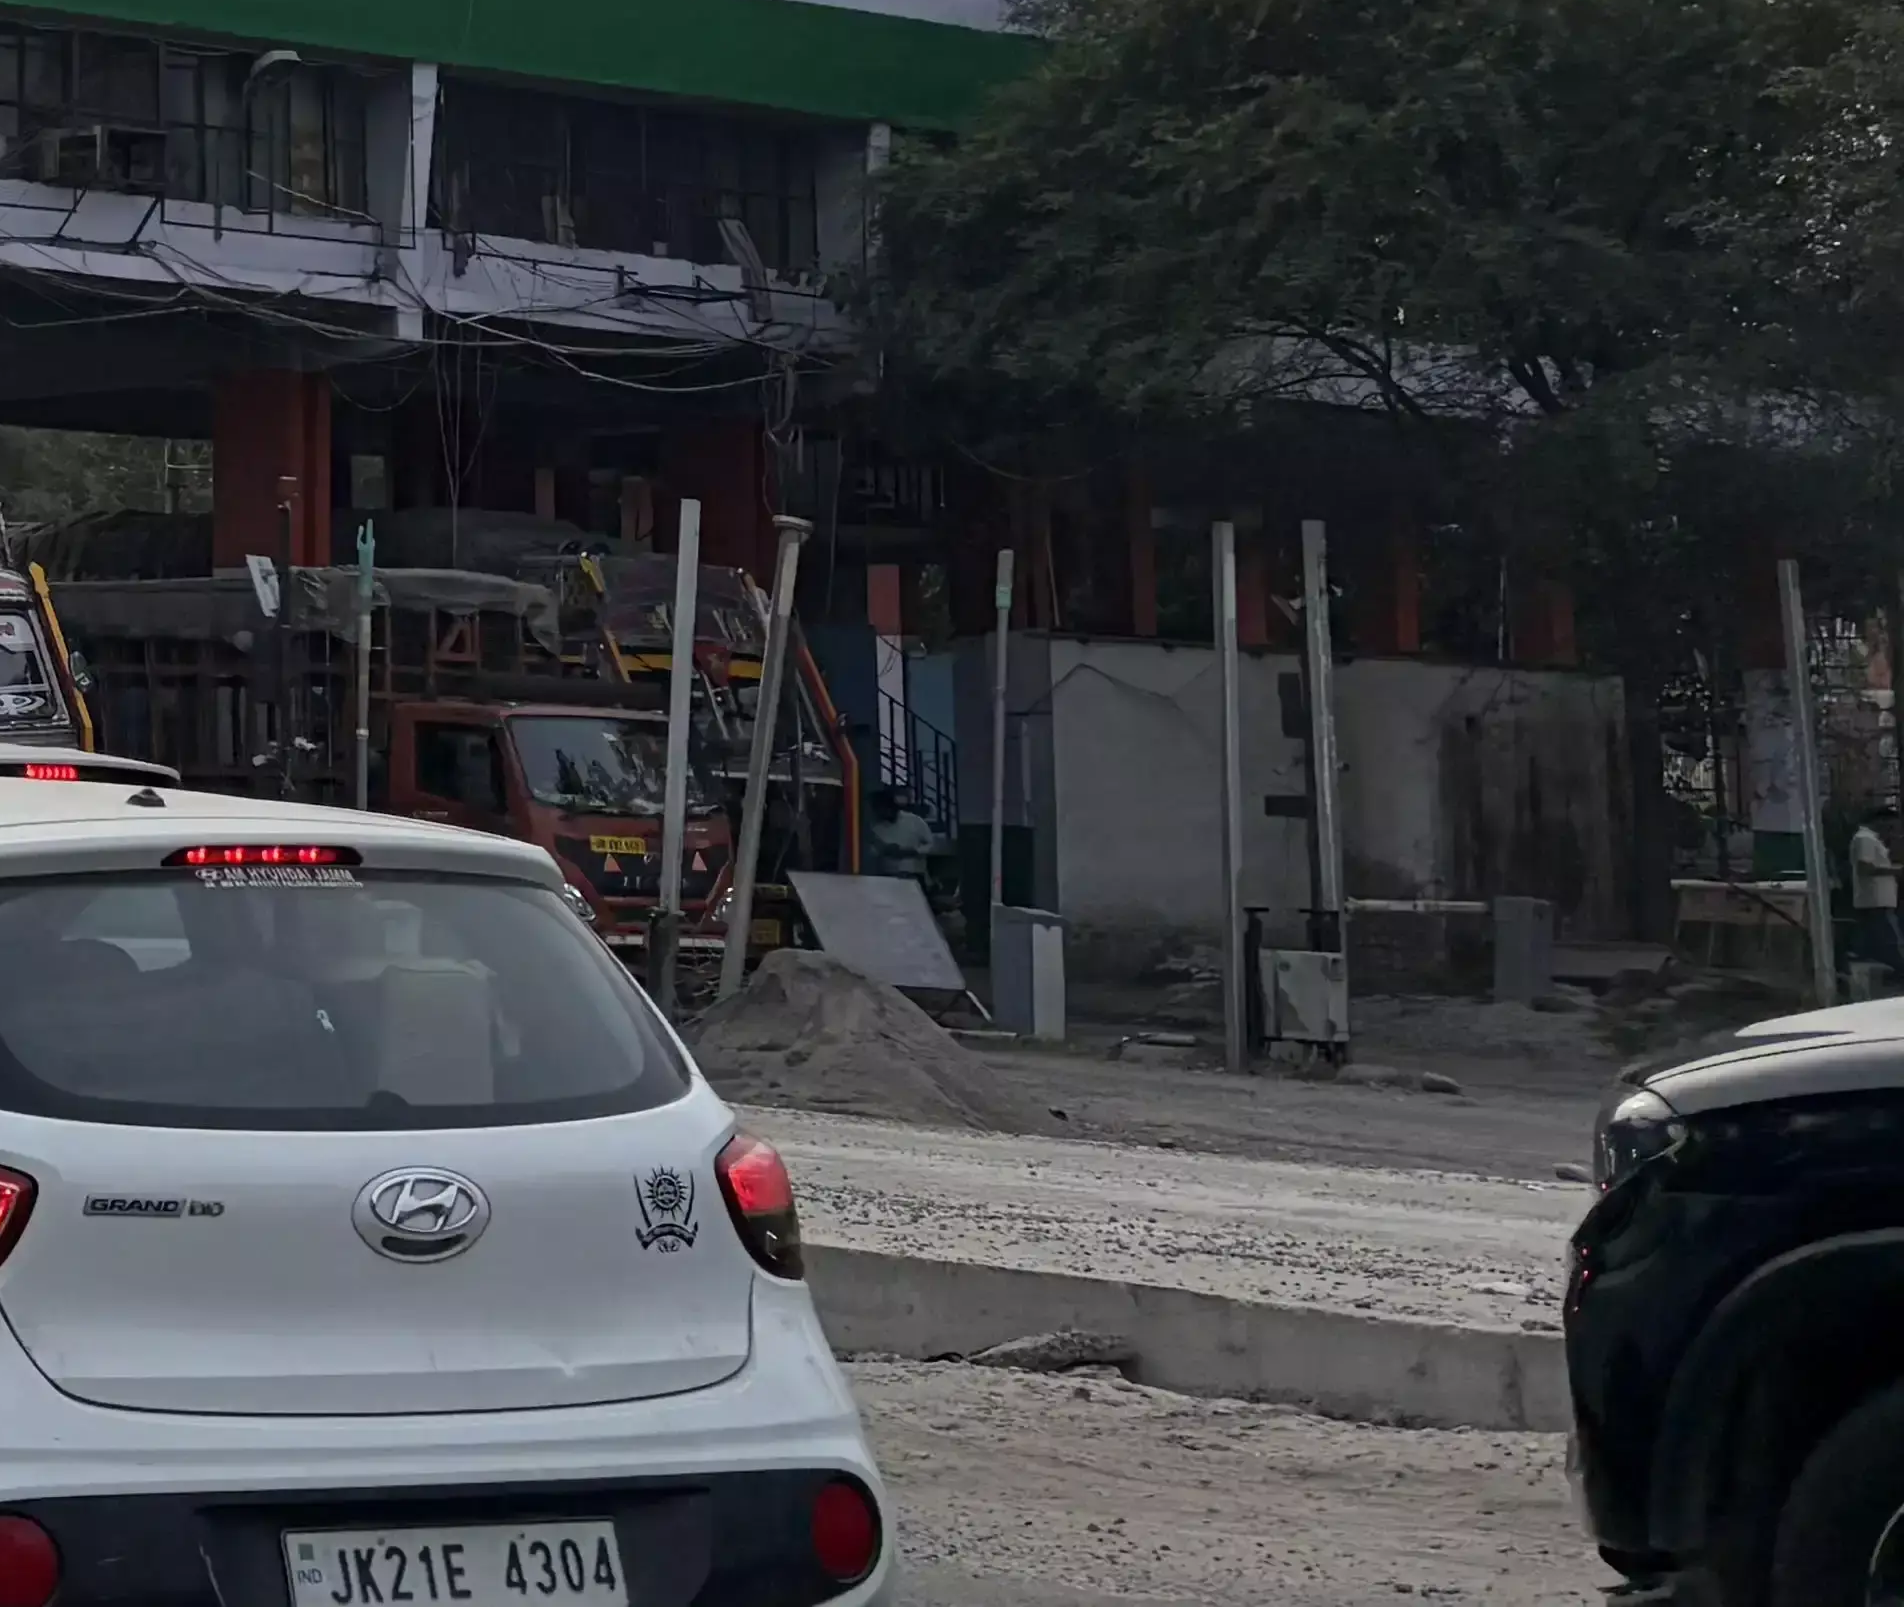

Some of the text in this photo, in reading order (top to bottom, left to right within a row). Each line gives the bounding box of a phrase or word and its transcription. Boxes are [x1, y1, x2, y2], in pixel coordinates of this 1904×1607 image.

[246, 867, 312, 882] HYUNDAI
[90, 1188, 180, 1212] GRAND
[297, 1568, 324, 1585] IND
[330, 1536, 616, 1606] JK21E 4304
